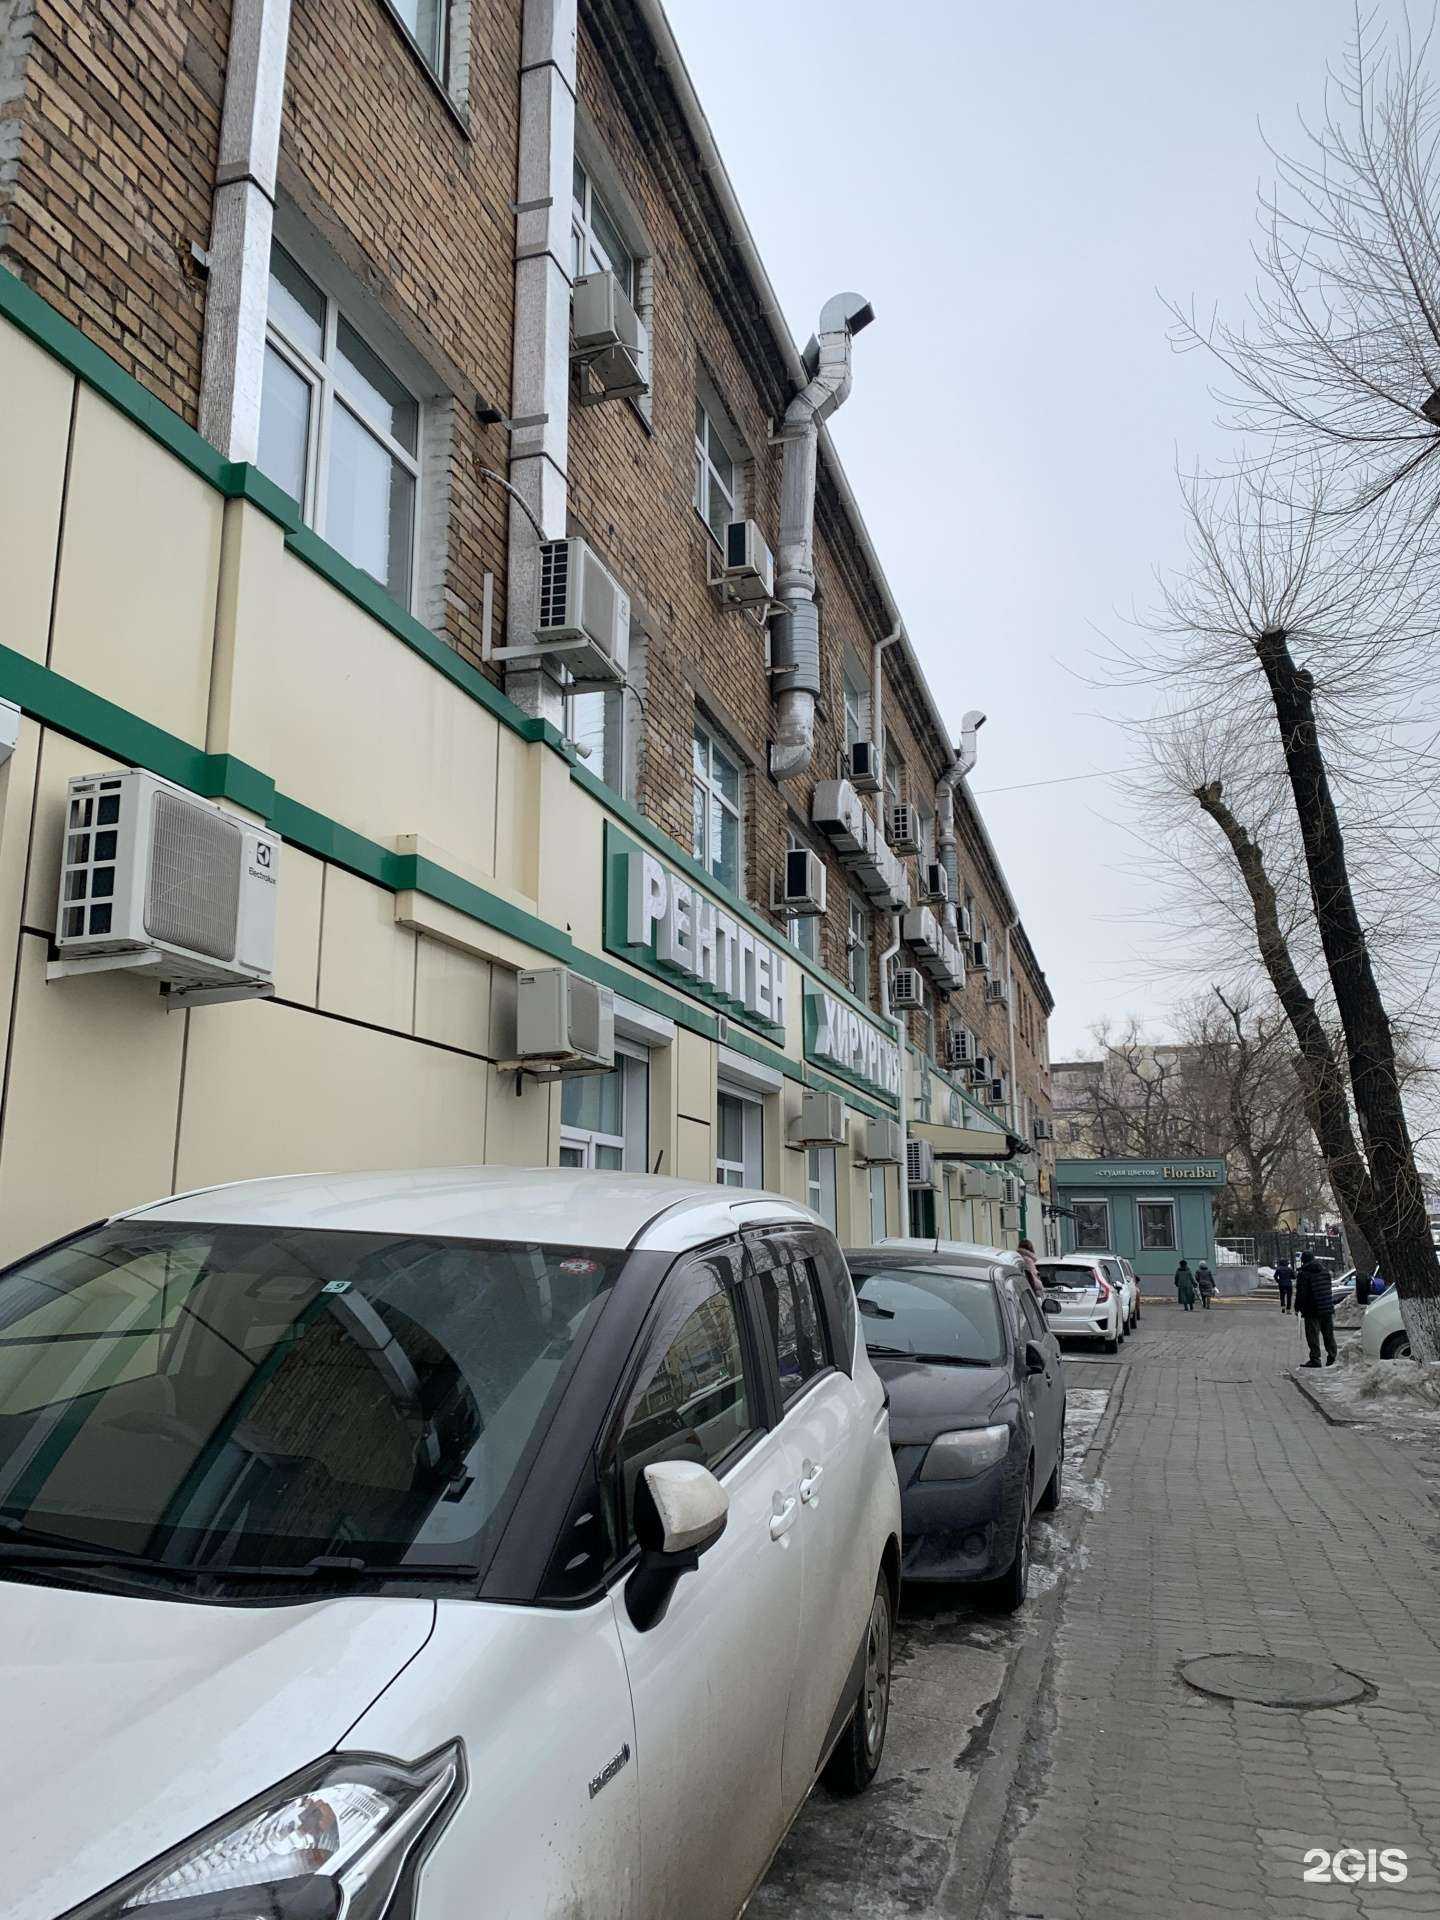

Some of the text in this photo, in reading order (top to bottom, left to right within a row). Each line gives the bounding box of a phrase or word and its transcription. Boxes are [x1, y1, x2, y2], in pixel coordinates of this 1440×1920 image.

[248, 866, 276, 885] Electrolux
[628, 850, 786, 1028] РЕНТГЕН
[1163, 1166, 1218, 1179] FloraBar
